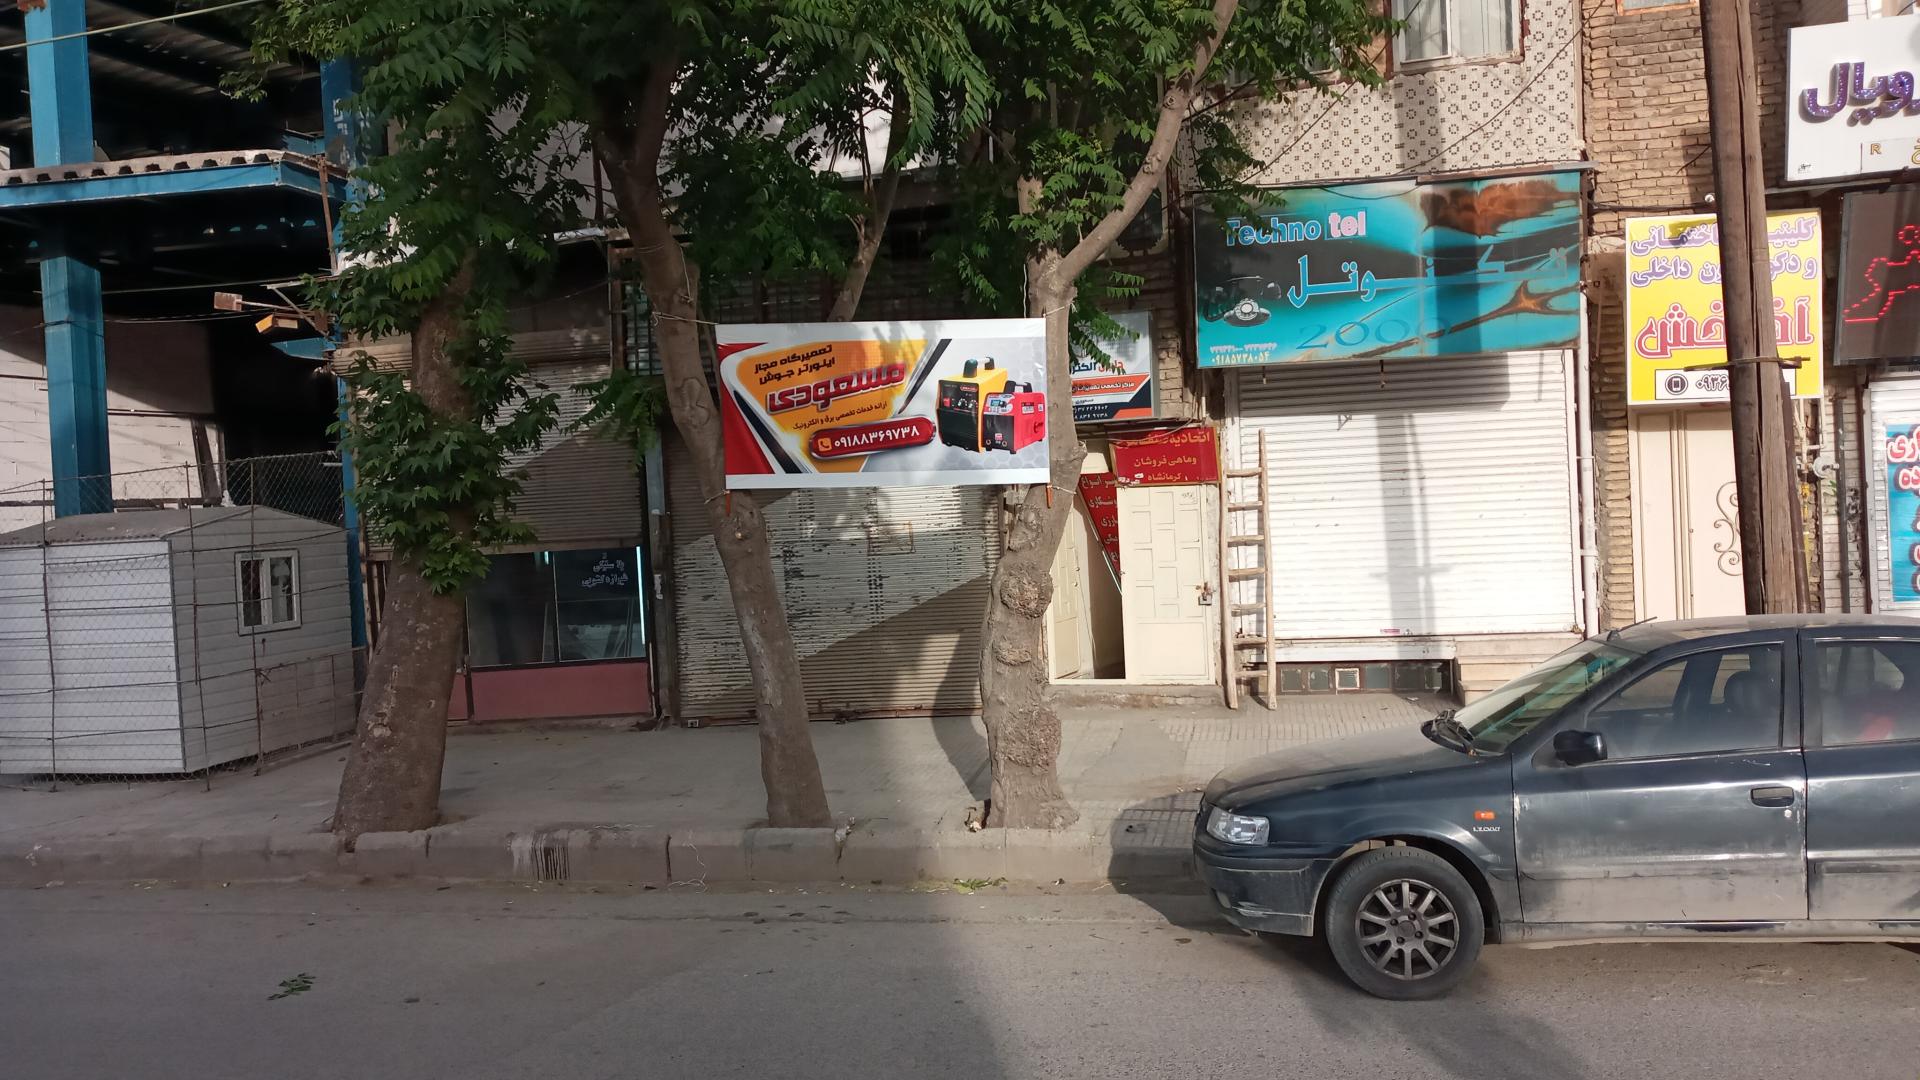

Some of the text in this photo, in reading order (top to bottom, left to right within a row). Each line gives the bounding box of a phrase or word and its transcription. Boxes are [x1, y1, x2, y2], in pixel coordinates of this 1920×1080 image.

[1328, 210, 1367, 238] tel
[1630, 217, 1817, 256] کلینی اختمانی
[1630, 255, 1693, 288] داخلی
[754, 344, 833, 374] تعمیرگاه مجاز
[759, 357, 836, 386] اینورتر جوش
[766, 363, 907, 416] مسعودی
[834, 425, 920, 448] ۰۹۱۸۸۳۶۹۷۳۸
[1170, 431, 1210, 447] اتحادیه
[1134, 455, 1167, 467] فروشان
[1147, 472, 1182, 482] کرمانشاه
